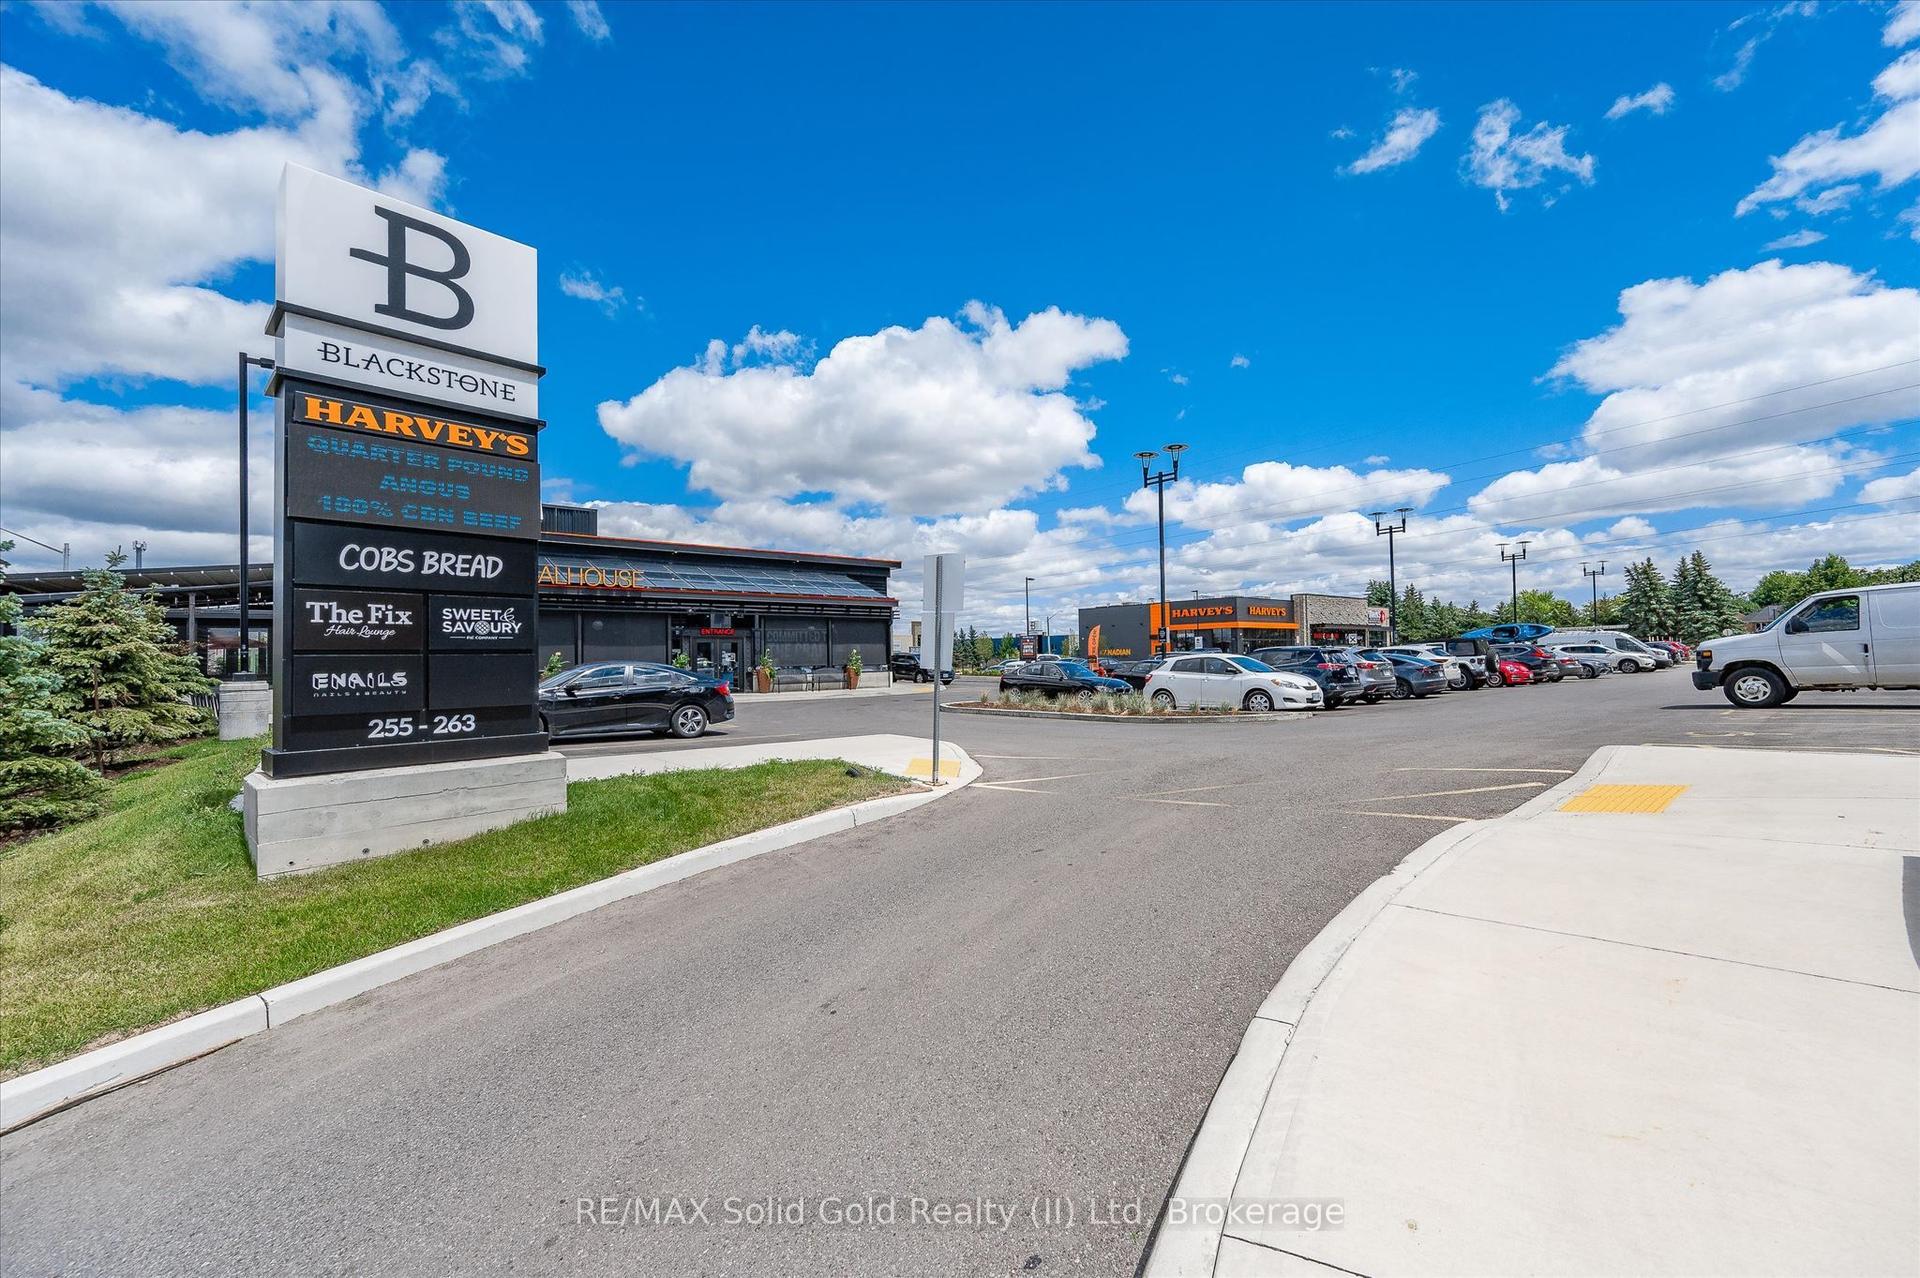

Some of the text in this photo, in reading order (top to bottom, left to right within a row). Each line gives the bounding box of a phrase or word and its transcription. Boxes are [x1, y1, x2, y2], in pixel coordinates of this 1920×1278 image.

[350, 205, 475, 330] B
[317, 341, 516, 402] BLACKSTONE
[304, 396, 529, 455] HARVEY'S
[306, 434, 529, 482] QUARTER POUND
[379, 474, 471, 500] ANGUS
[317, 495, 522, 530] 100% CDN BEEF
[339, 544, 503, 579] COBS BREAD
[305, 602, 413, 625] The Fix
[1172, 606, 1233, 618] HARVEY'S
[324, 625, 397, 640] Hair Lounge
[312, 672, 408, 690] ENAILS
[367, 717, 414, 738] 255
[433, 714, 476, 734] 263
